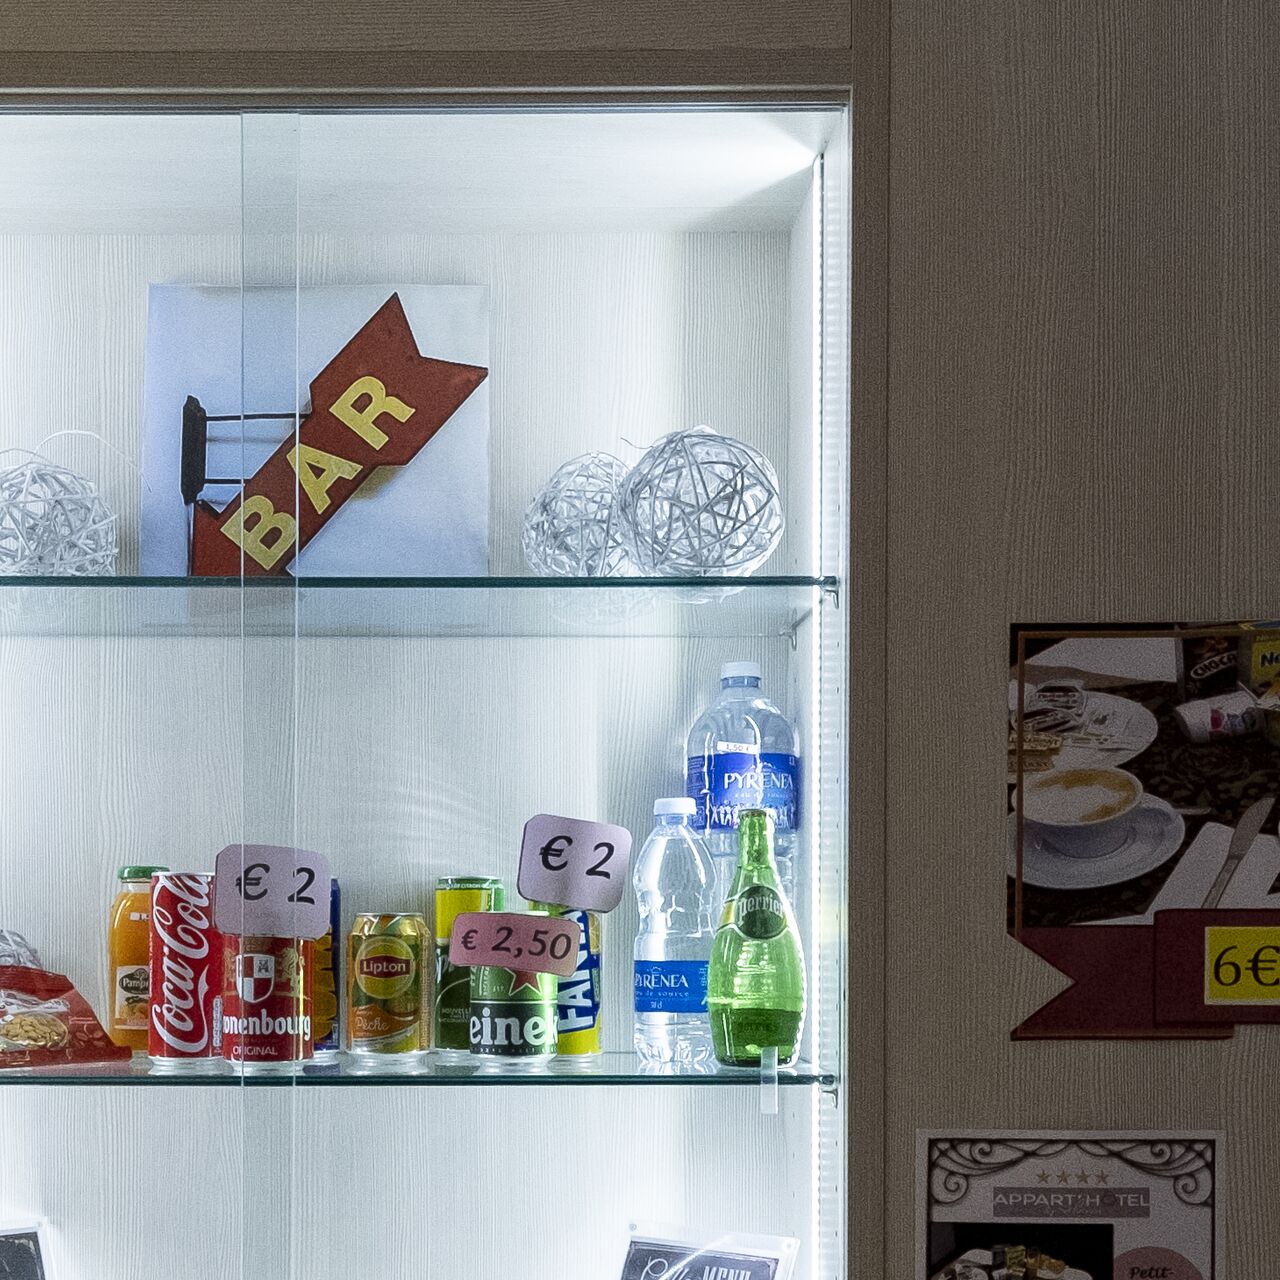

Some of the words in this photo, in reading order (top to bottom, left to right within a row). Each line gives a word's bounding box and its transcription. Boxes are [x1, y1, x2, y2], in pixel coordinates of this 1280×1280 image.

[220, 375, 417, 571] BAR
[539, 834, 574, 872] €
[584, 841, 616, 880] 2
[235, 863, 271, 901] €
[287, 866, 317, 905] 2
[460, 928, 480, 951] €
[490, 926, 572, 961] 2,50
[362, 960, 407, 974] Lipton
[232, 1045, 279, 1057] ORIGINAL
[1129, 1264, 1175, 1280] Petit-
